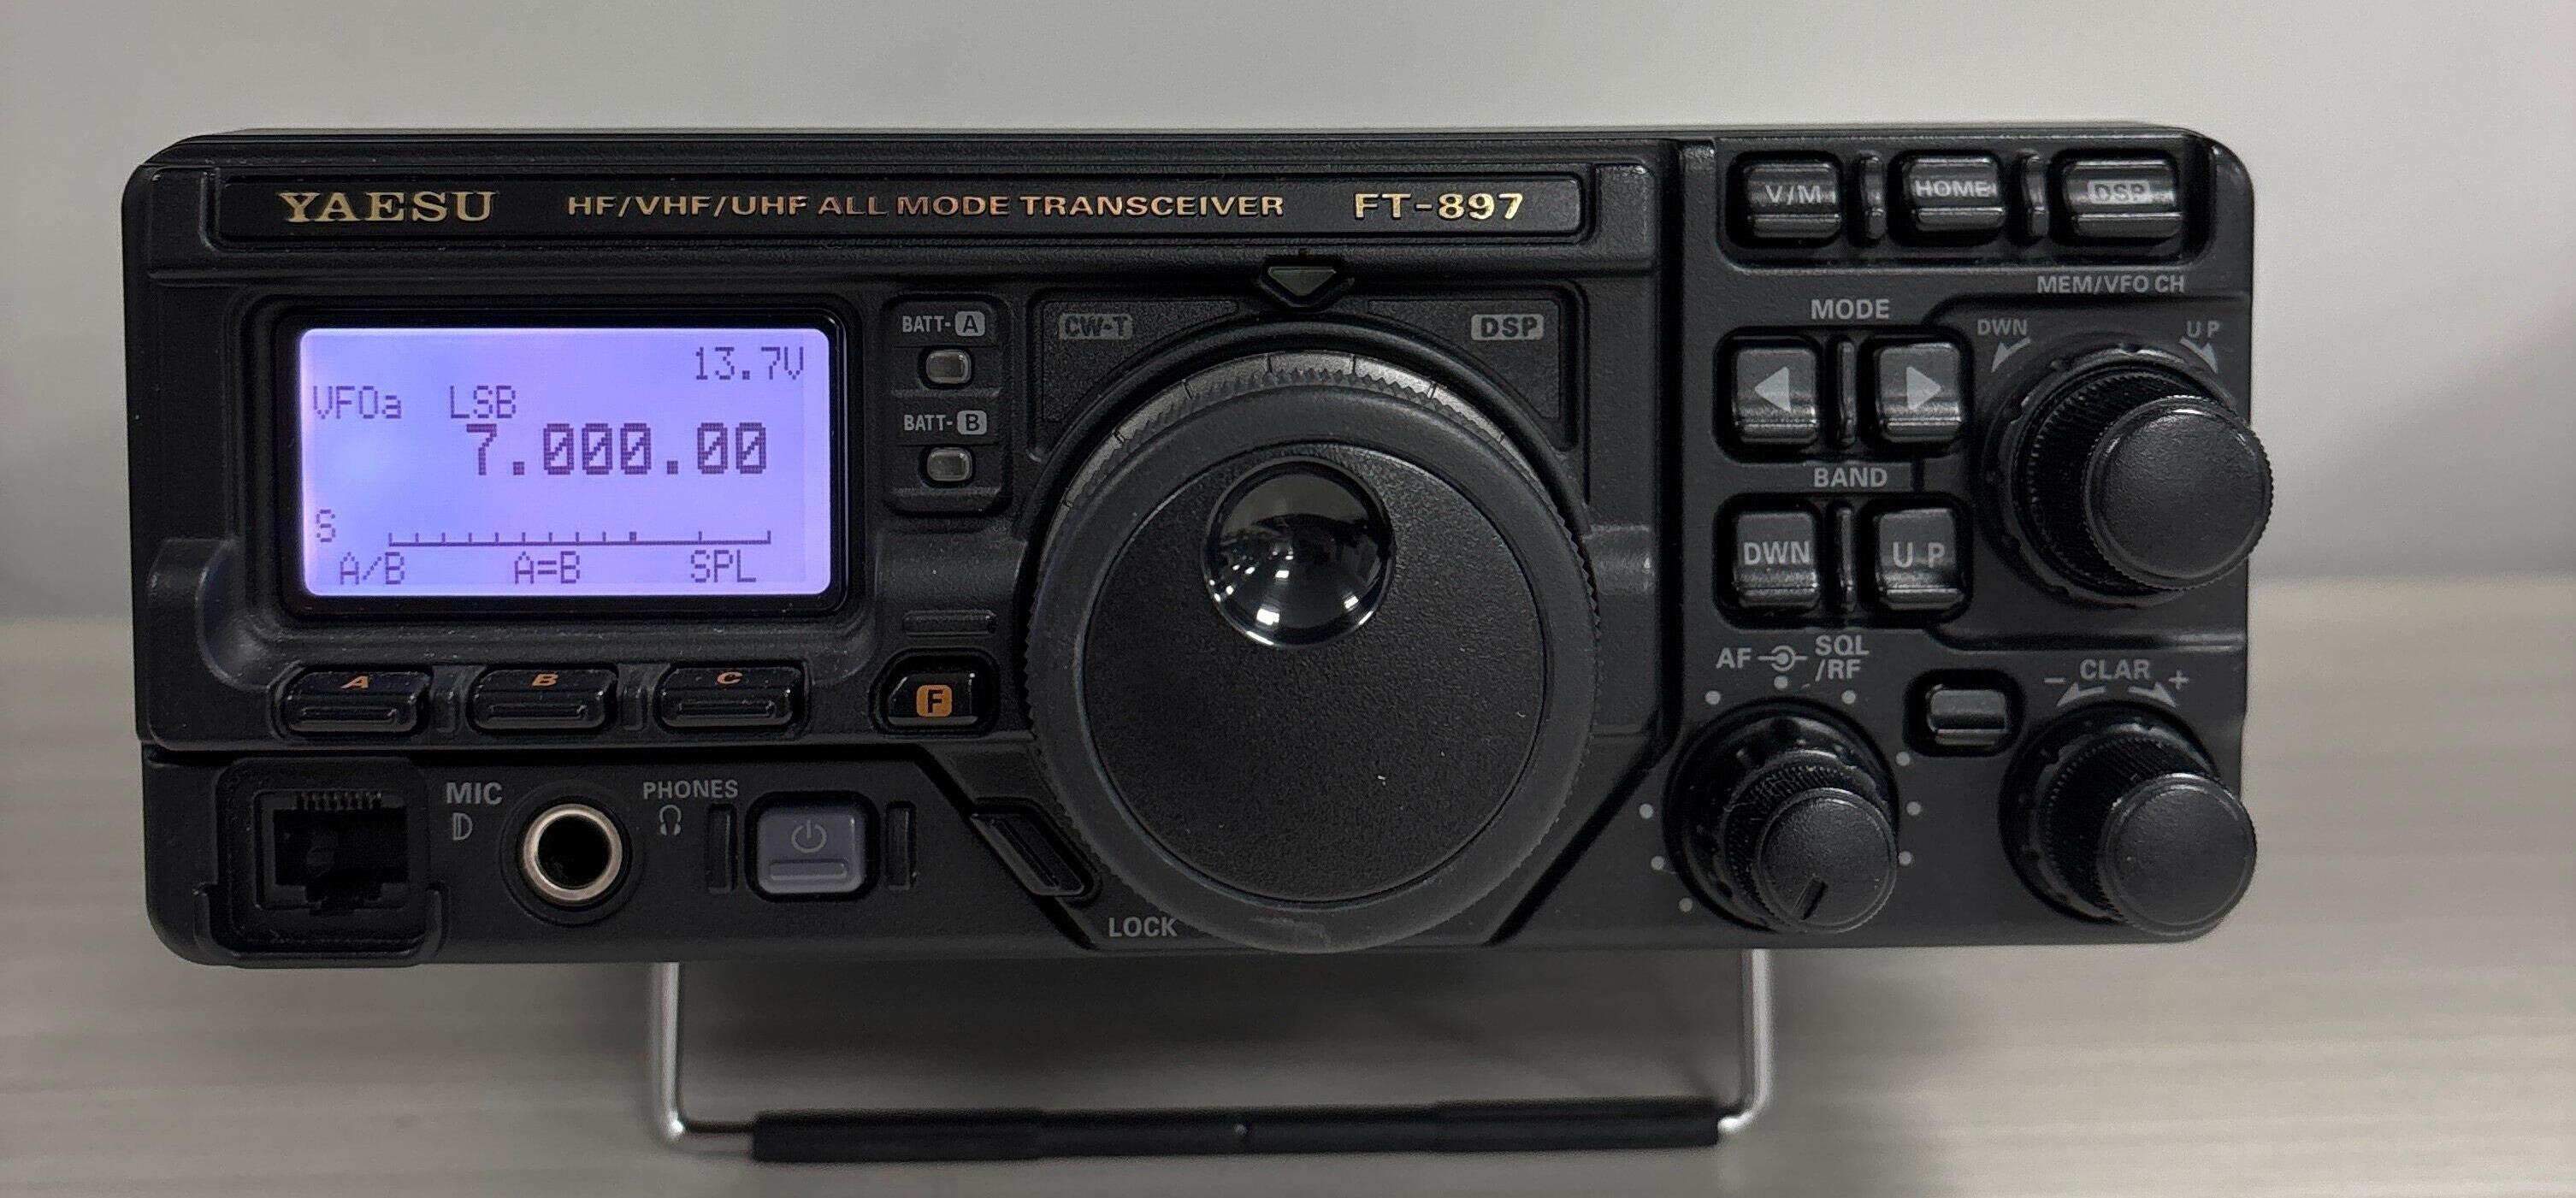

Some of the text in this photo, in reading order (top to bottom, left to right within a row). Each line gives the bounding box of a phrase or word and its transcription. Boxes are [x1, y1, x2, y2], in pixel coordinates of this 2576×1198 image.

[1764, 185, 1823, 205] V/M
[1914, 179, 1992, 198] HOME
[279, 190, 500, 223] YAESU
[568, 195, 1284, 217] HF/VHF/UHF ALL MODE TRANSCEIVER
[1352, 192, 1526, 220] FT-897
[2036, 274, 2186, 294] MEM/VFO CH
[1810, 298, 1890, 321] MODE
[1480, 316, 1539, 338] DSP
[1976, 318, 2029, 338] DWN
[695, 345, 805, 381] 13.7V
[312, 386, 517, 419] VFOa LSB
[466, 422, 767, 475] 7.000.00
[1813, 467, 1888, 489] BAND
[315, 509, 336, 543] S
[1743, 540, 1811, 566] DWN
[340, 552, 405, 585] A/B
[514, 551, 581, 584] A=B
[691, 550, 757, 583] SPL
[1814, 634, 1870, 658] SQL
[1715, 647, 1753, 670] AF
[1813, 658, 1863, 683] /RF
[2078, 658, 2154, 682] CLAR
[341, 675, 371, 689] A
[531, 673, 559, 687] B
[717, 670, 743, 685] C
[924, 687, 947, 716] F
[445, 781, 504, 806] MIC
[641, 779, 740, 800] PHONES
[1108, 916, 1179, 939] LOCK
